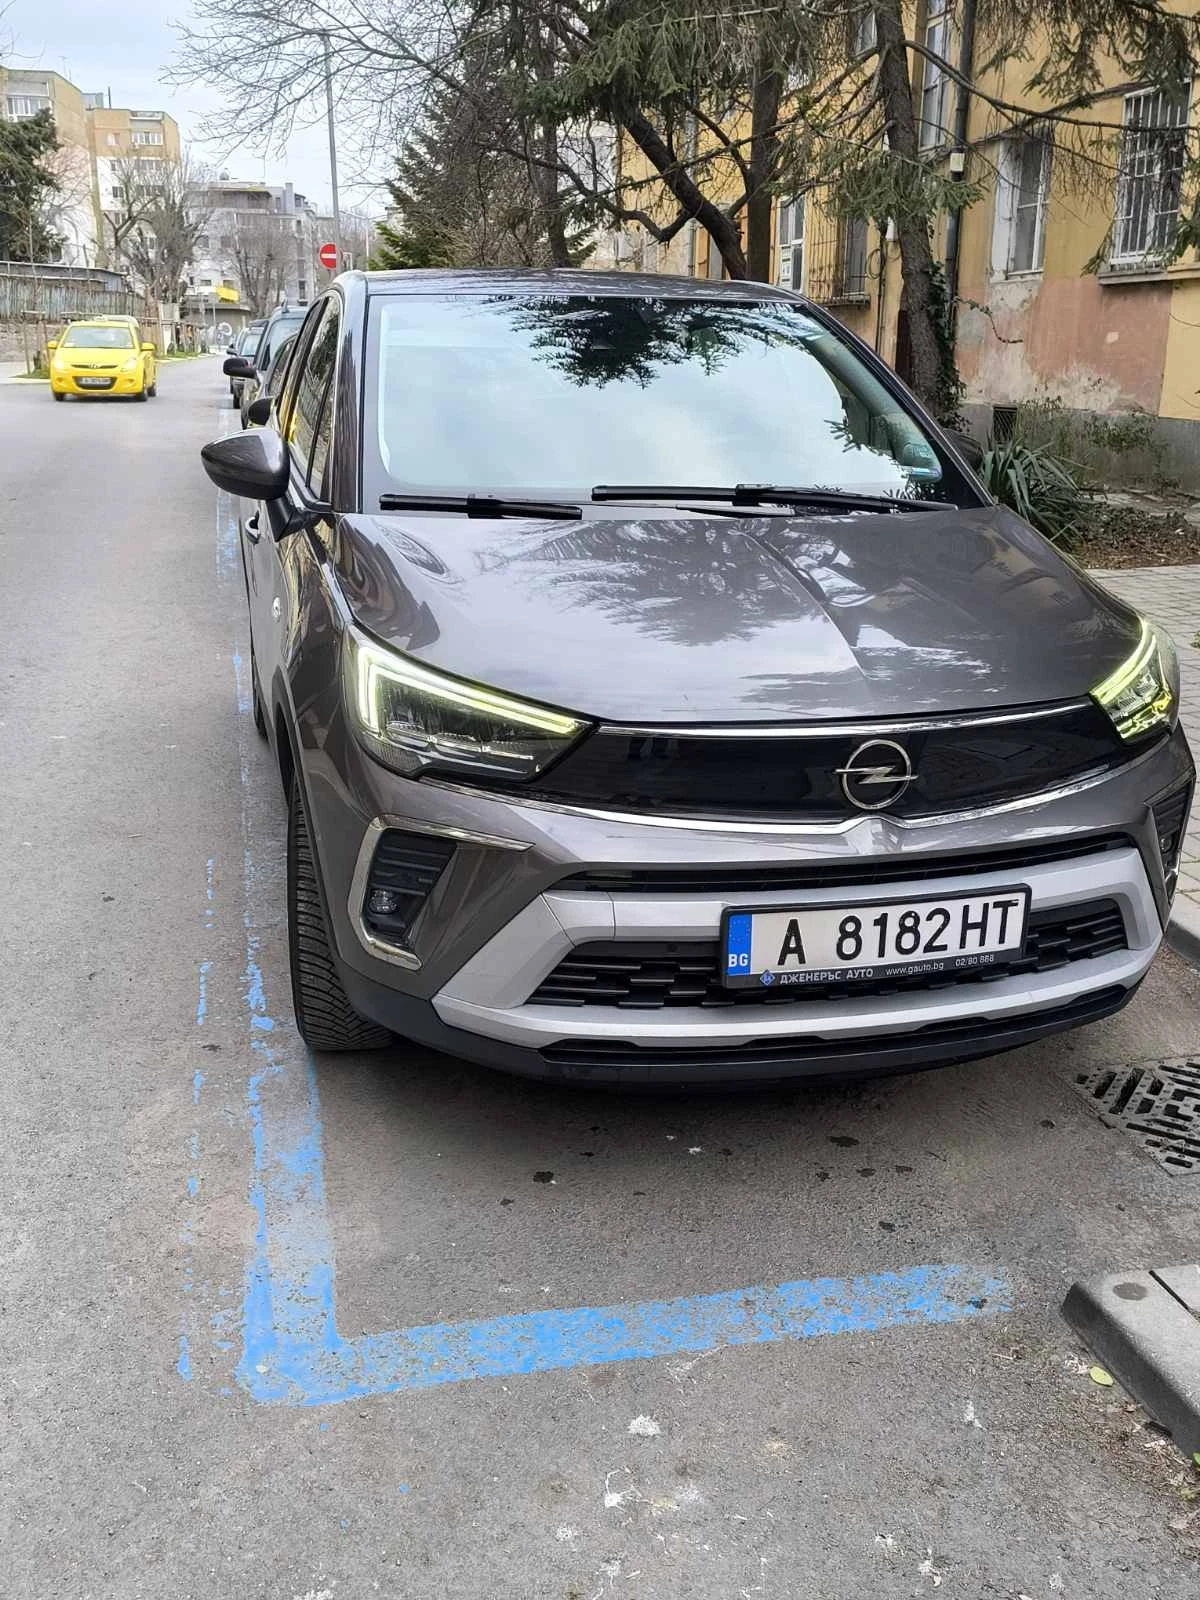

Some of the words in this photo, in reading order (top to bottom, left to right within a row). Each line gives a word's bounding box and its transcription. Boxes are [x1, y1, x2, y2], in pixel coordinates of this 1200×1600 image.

[728, 953, 749, 968] BG
[780, 970, 841, 985] ДЖЕНЕРЪС
[846, 968, 873, 980] АУТО
[885, 962, 944, 976] www.gauto.bg
